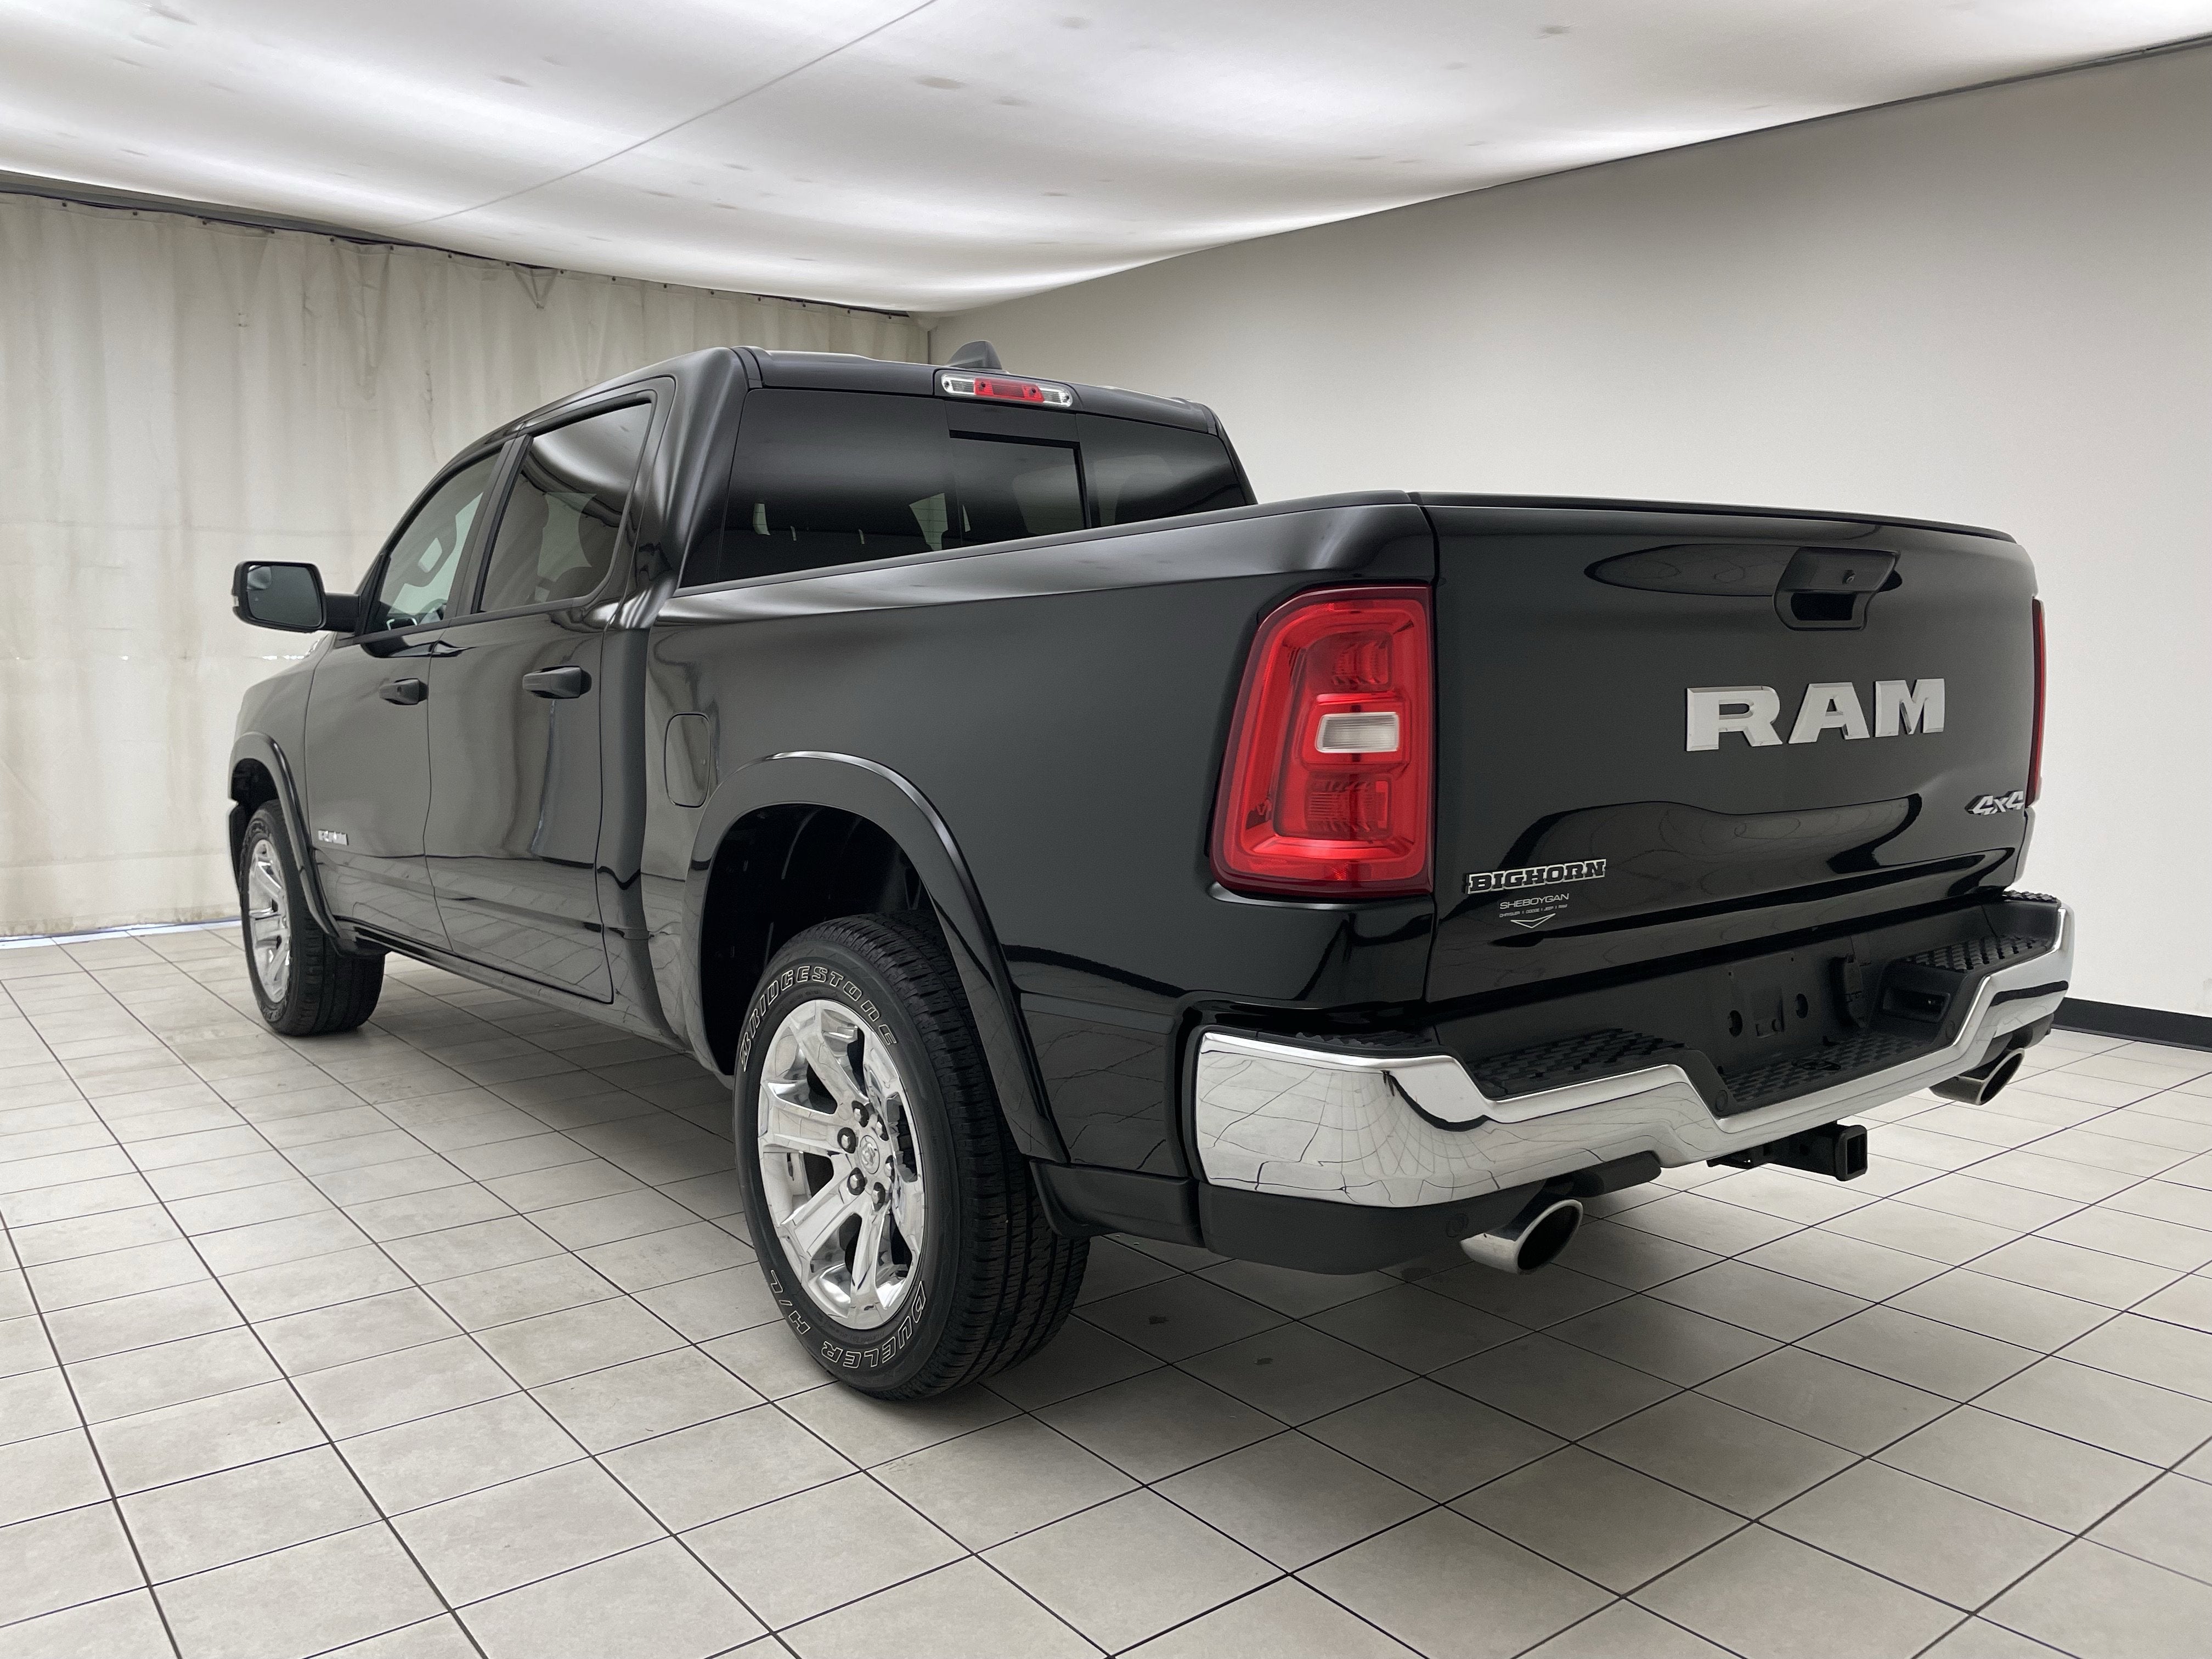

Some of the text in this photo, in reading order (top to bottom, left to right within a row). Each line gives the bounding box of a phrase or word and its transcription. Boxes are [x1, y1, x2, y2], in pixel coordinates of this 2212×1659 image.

[1686, 678, 1945, 752] RAM
[1966, 791, 2024, 816] 4x4
[1466, 859, 1606, 894] BIGHORN
[1499, 893, 1570, 910] SHEBOYGAN
[740, 966, 897, 1072] BRIDGESTONE
[821, 1281, 926, 1368] DUELER
